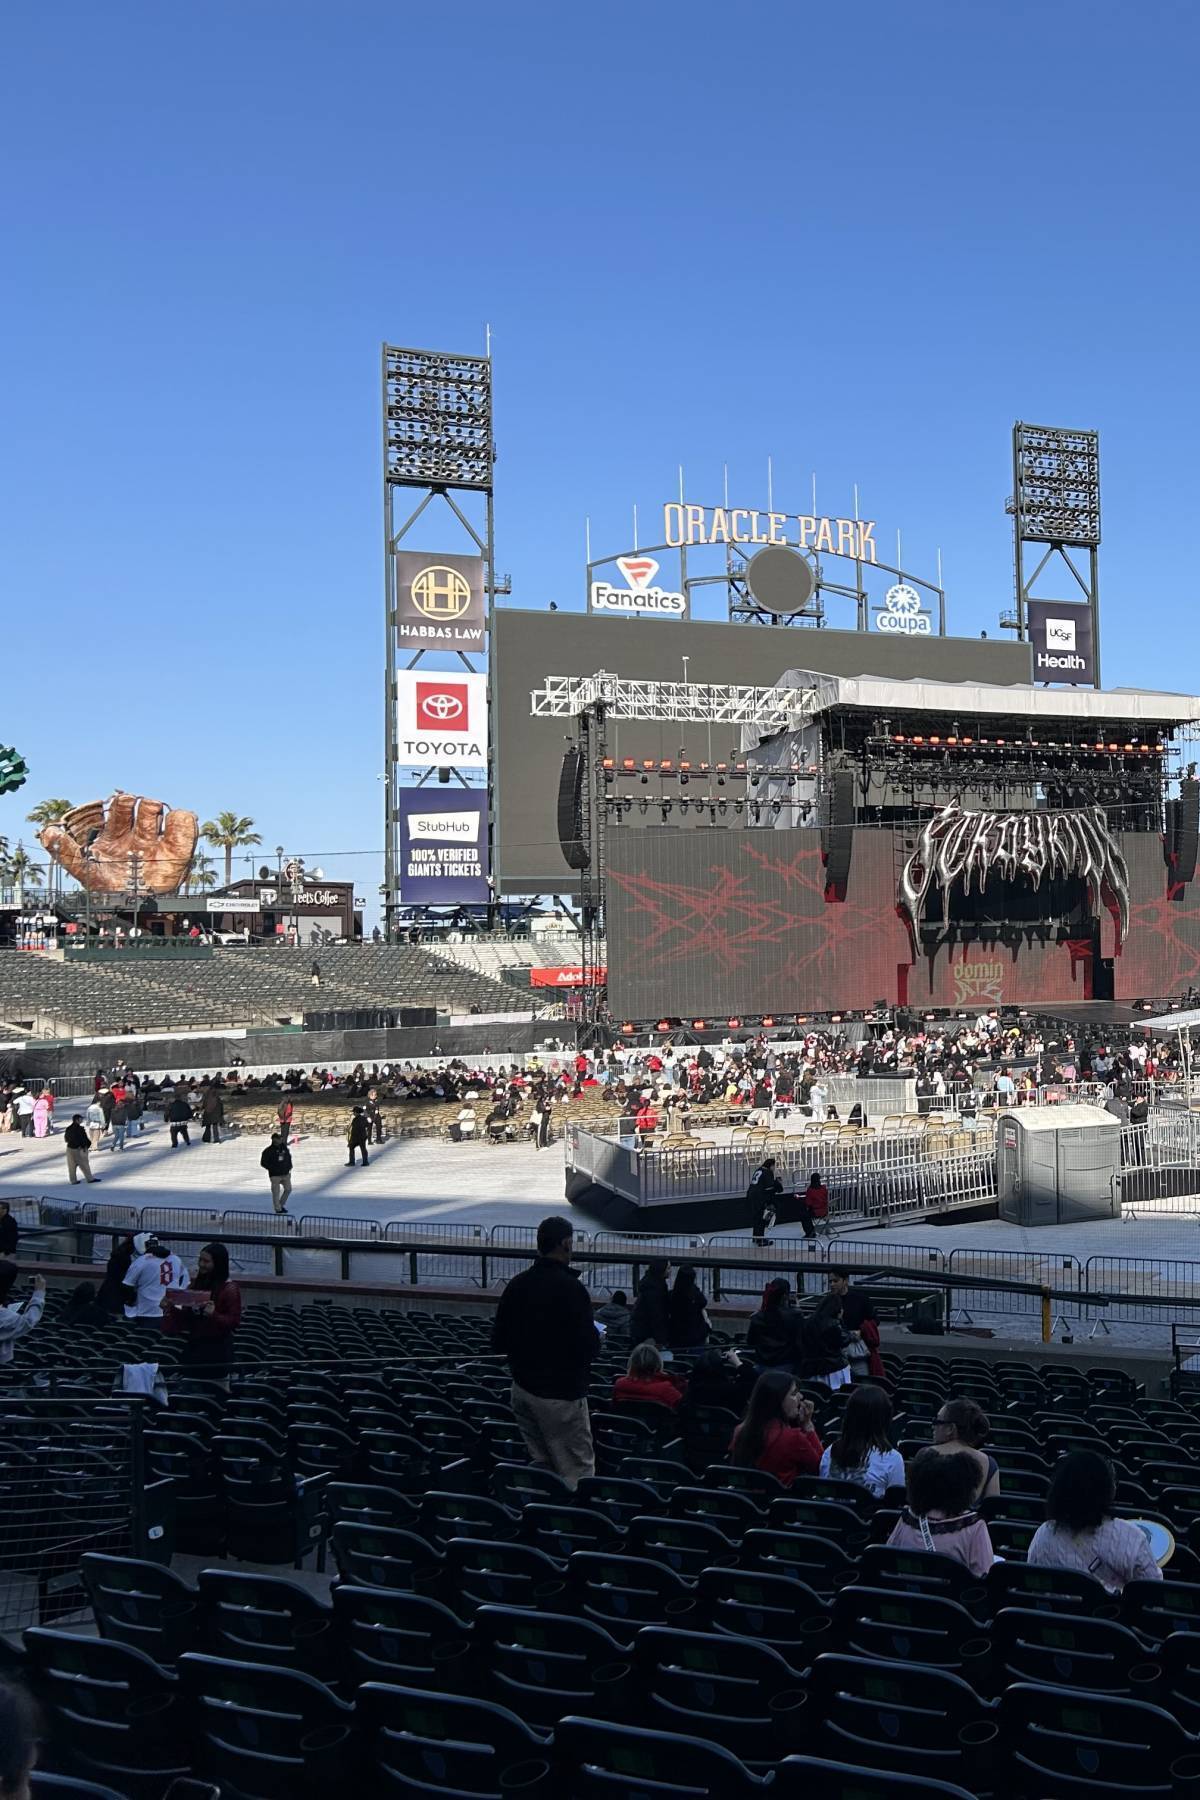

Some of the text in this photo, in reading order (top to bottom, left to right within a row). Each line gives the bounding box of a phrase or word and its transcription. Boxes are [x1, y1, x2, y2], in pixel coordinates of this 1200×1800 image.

[663, 502, 879, 565] ORACLE PARK
[596, 586, 682, 610] Fanatics
[400, 624, 482, 640] HABBAS LAW
[879, 615, 928, 633] coupa
[1049, 628, 1073, 642] UCSF
[1037, 652, 1086, 670] Health
[403, 741, 482, 756] TOYOTA
[417, 821, 470, 833] StubHub
[411, 848, 479, 862] 100% VERIFIED
[407, 863, 482, 877] GIANTS TICKETS
[314, 890, 339, 907] Coffee
[160, 1261, 173, 1286] 8
